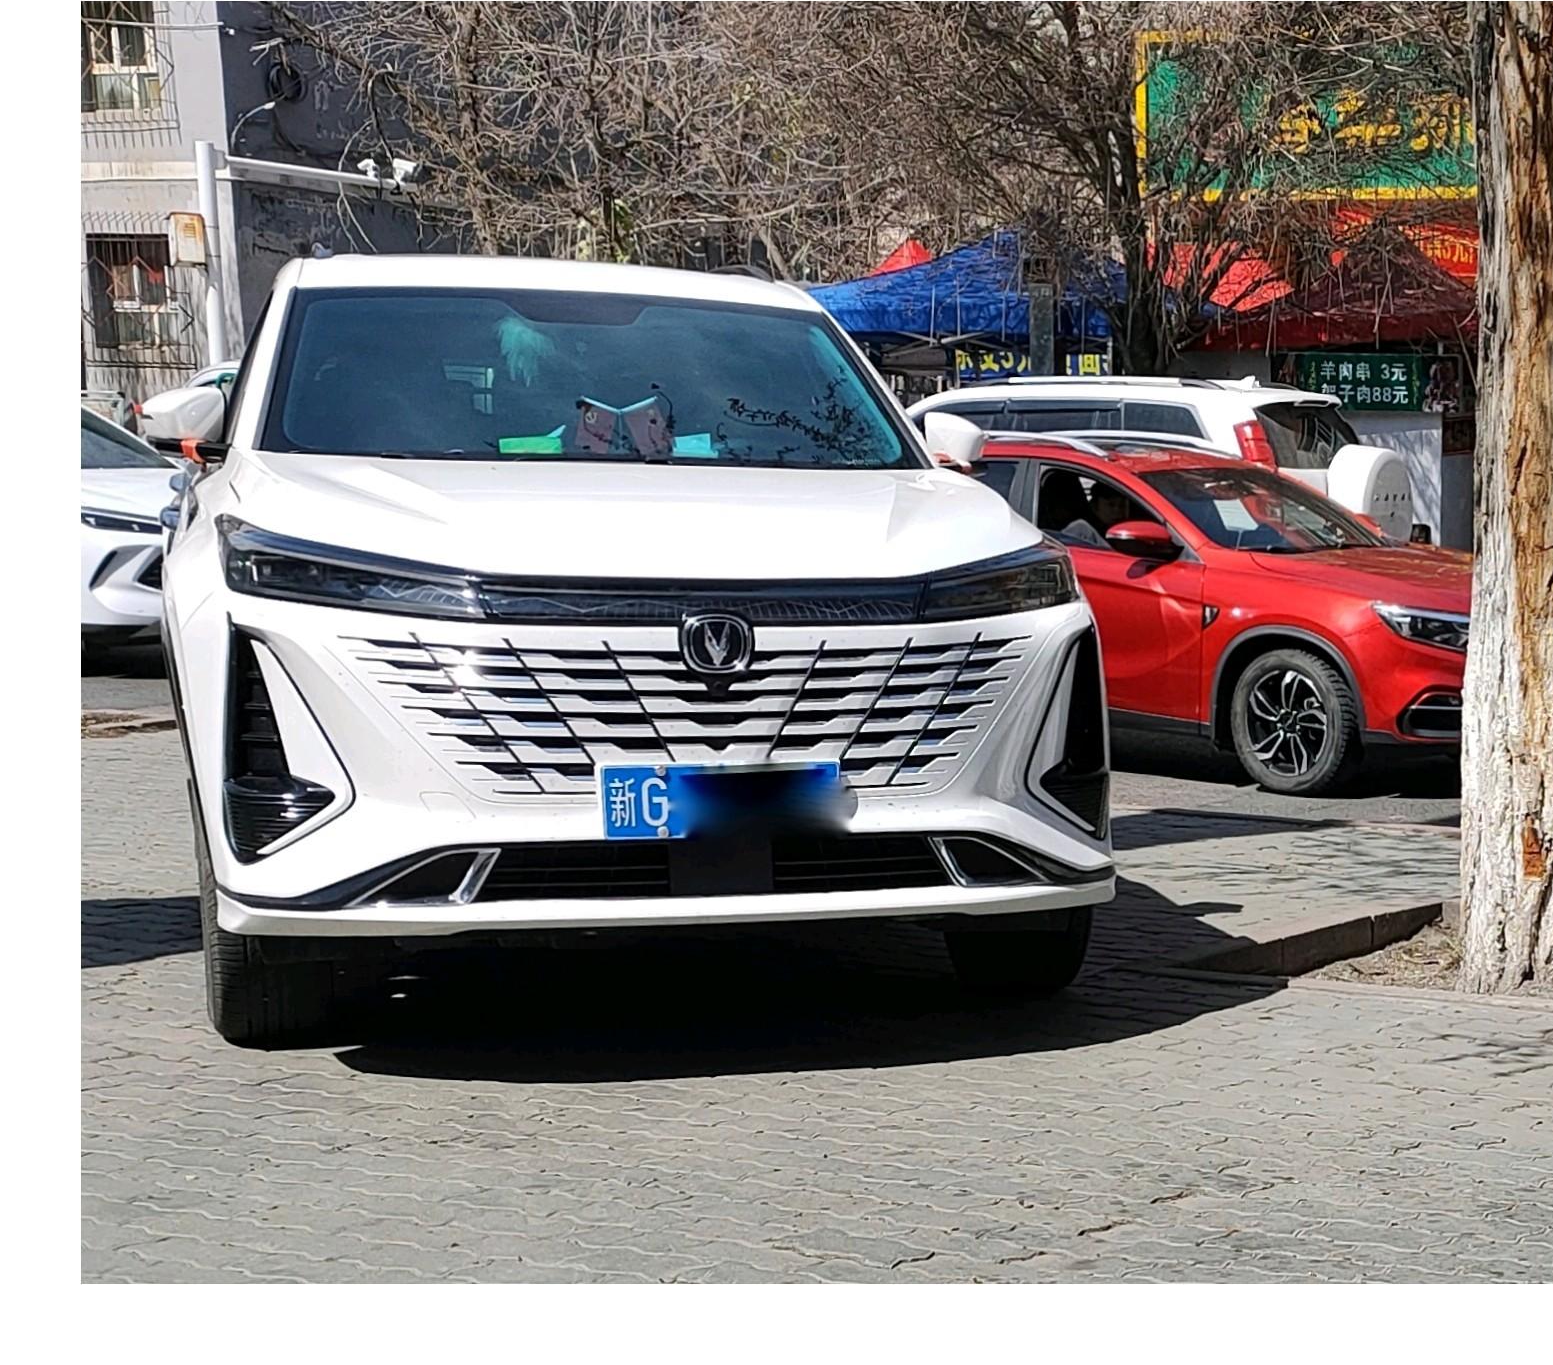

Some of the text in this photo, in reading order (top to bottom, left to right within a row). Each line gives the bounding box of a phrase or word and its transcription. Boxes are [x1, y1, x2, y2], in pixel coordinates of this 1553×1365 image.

[1320, 360, 1407, 381] 羊肉串 3元
[609, 777, 669, 828] 新G
